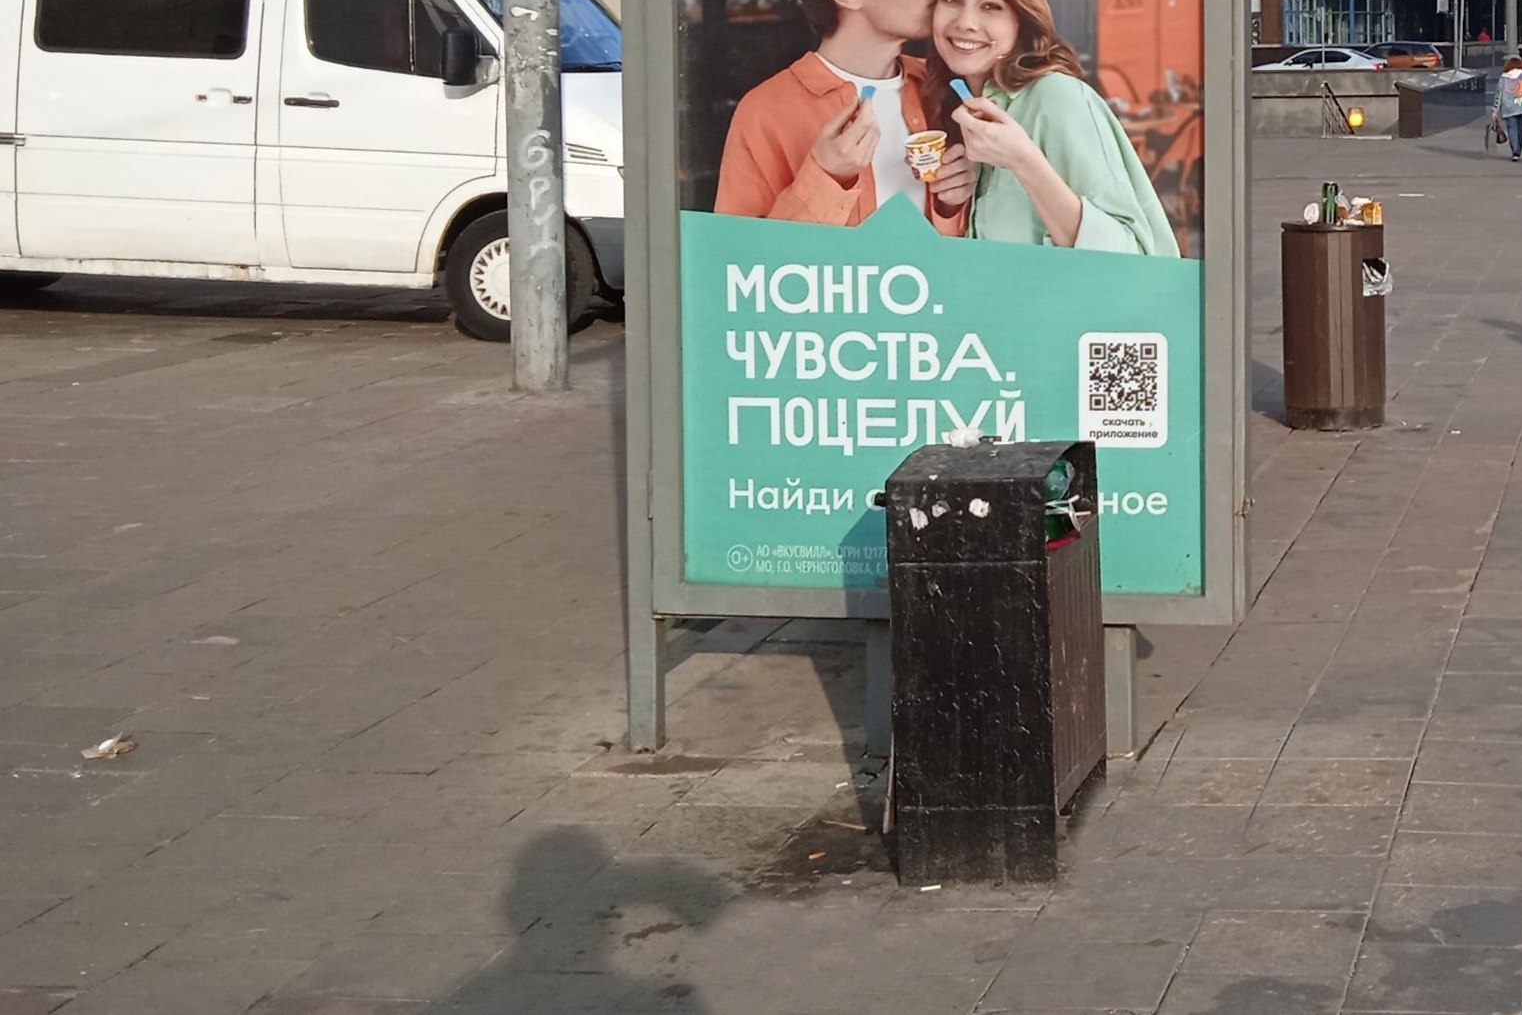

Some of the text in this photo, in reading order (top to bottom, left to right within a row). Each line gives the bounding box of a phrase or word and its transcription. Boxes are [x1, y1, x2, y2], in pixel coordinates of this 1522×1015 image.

[726, 330, 1018, 382] ЧУВСТВА.
[1102, 418, 1146, 427] скачать
[1089, 430, 1159, 440] приложение
[728, 477, 855, 515] Найди
[730, 550, 749, 565] 0+
[756, 545, 770, 557] АО
